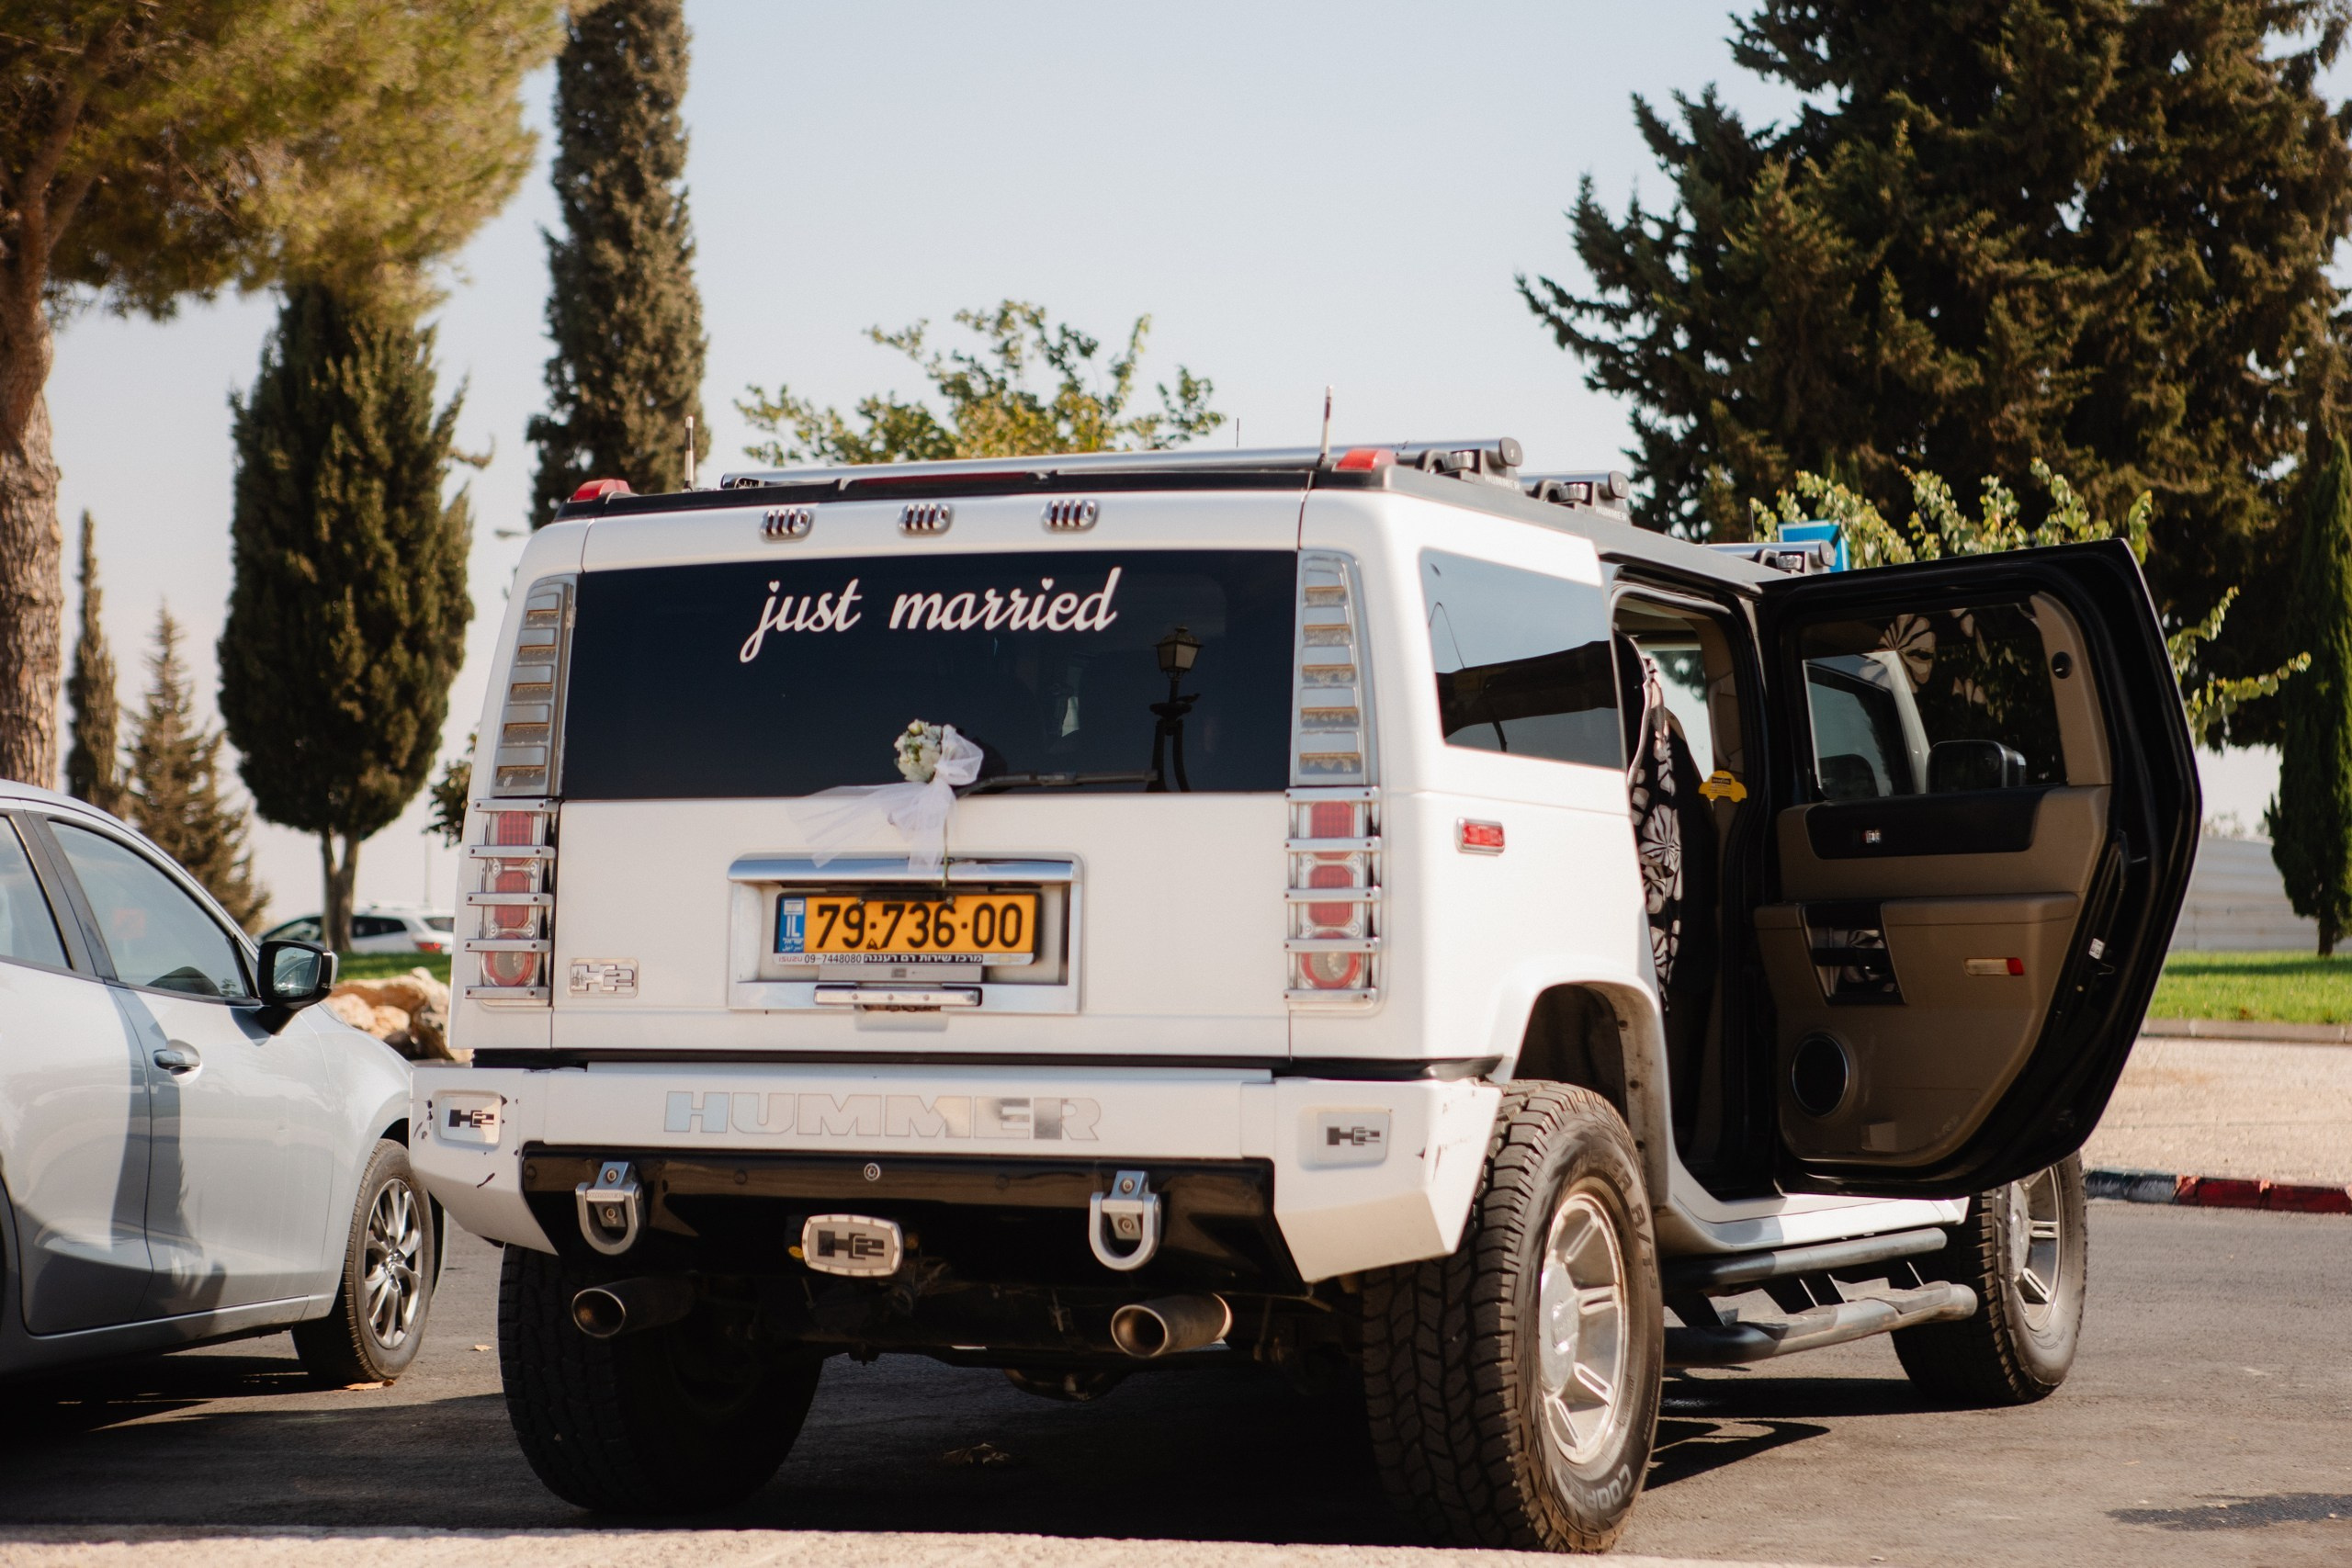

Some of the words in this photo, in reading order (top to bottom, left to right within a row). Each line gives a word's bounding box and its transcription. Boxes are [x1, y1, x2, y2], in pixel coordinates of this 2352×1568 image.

[740, 578, 862, 662] just
[888, 567, 1122, 631] married
[786, 915, 800, 937] IL
[804, 953, 862, 964] 09-7448080
[864, 953, 898, 963] רעננה
[899, 953, 916, 963] רם
[919, 953, 952, 963] שירות
[955, 953, 982, 963] מרכז
[448, 1109, 495, 1128] H2
[663, 1090, 1102, 1142] HUMMER
[1326, 1126, 1381, 1146] H2
[817, 1229, 885, 1260] H2
